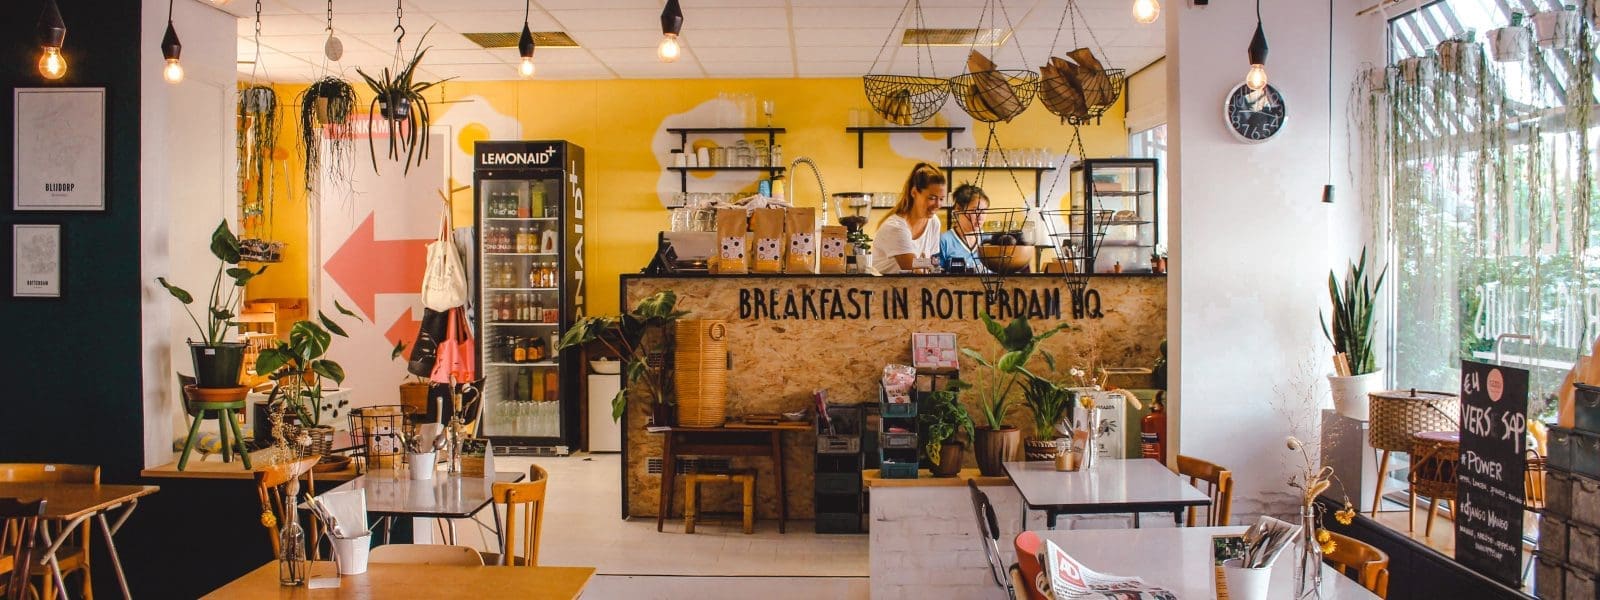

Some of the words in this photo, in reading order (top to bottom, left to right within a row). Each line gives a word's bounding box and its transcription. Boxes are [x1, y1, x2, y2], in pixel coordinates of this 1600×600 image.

[1232, 115, 1241, 129] 8
[1270, 114, 1279, 128] 4
[1241, 124, 1249, 136] 7
[1251, 127, 1261, 140] 6
[1262, 123, 1271, 137] 5
[45, 183, 75, 192] BLIJDORP
[739, 288, 873, 320] BREAKFAST
[883, 288, 909, 319] IN
[921, 287, 1061, 320] ROTTERDAM
[1072, 287, 1104, 319] HQ
[1461, 403, 1492, 437] VERS
[1501, 411, 1525, 455] SAP
